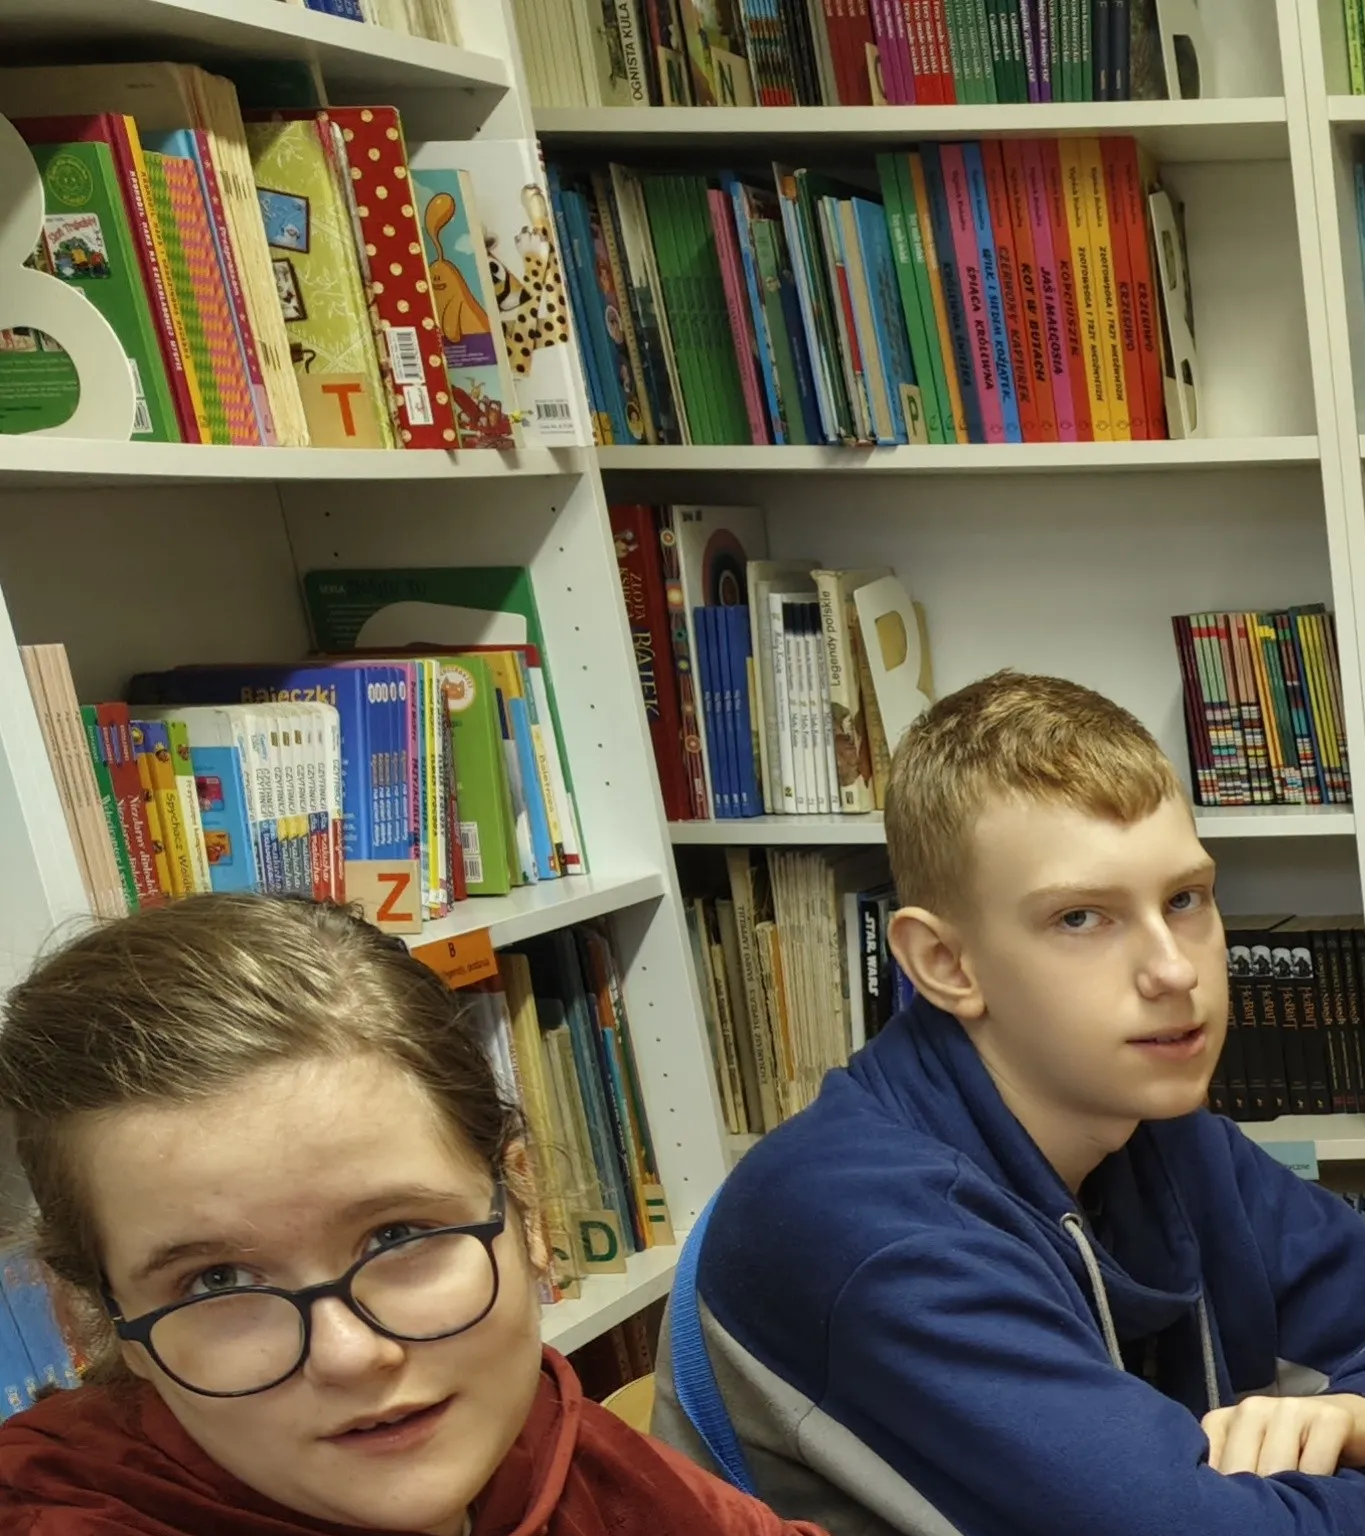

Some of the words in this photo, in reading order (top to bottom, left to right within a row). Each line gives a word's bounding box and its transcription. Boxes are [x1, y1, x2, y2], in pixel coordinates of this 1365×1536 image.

[618, 2, 633, 37] KULA
[625, 40, 643, 101] OGNISTA
[966, 264, 984, 311] ŚPIĄCA
[975, 318, 998, 389] KRÓLEWNA
[1019, 262, 1035, 296] KOT
[1028, 318, 1048, 382] BUTACH
[1060, 259, 1080, 357] KOPCIUSZEK
[321, 383, 363, 437] T
[821, 590, 836, 635] polskie
[826, 635, 841, 687] Legendy
[161, 791, 186, 851] Spychacz
[377, 873, 413, 922] Z
[448, 942, 456, 957] B
[864, 911, 877, 953] STAR
[866, 954, 879, 996] WARS
[580, 1220, 618, 1262] D
